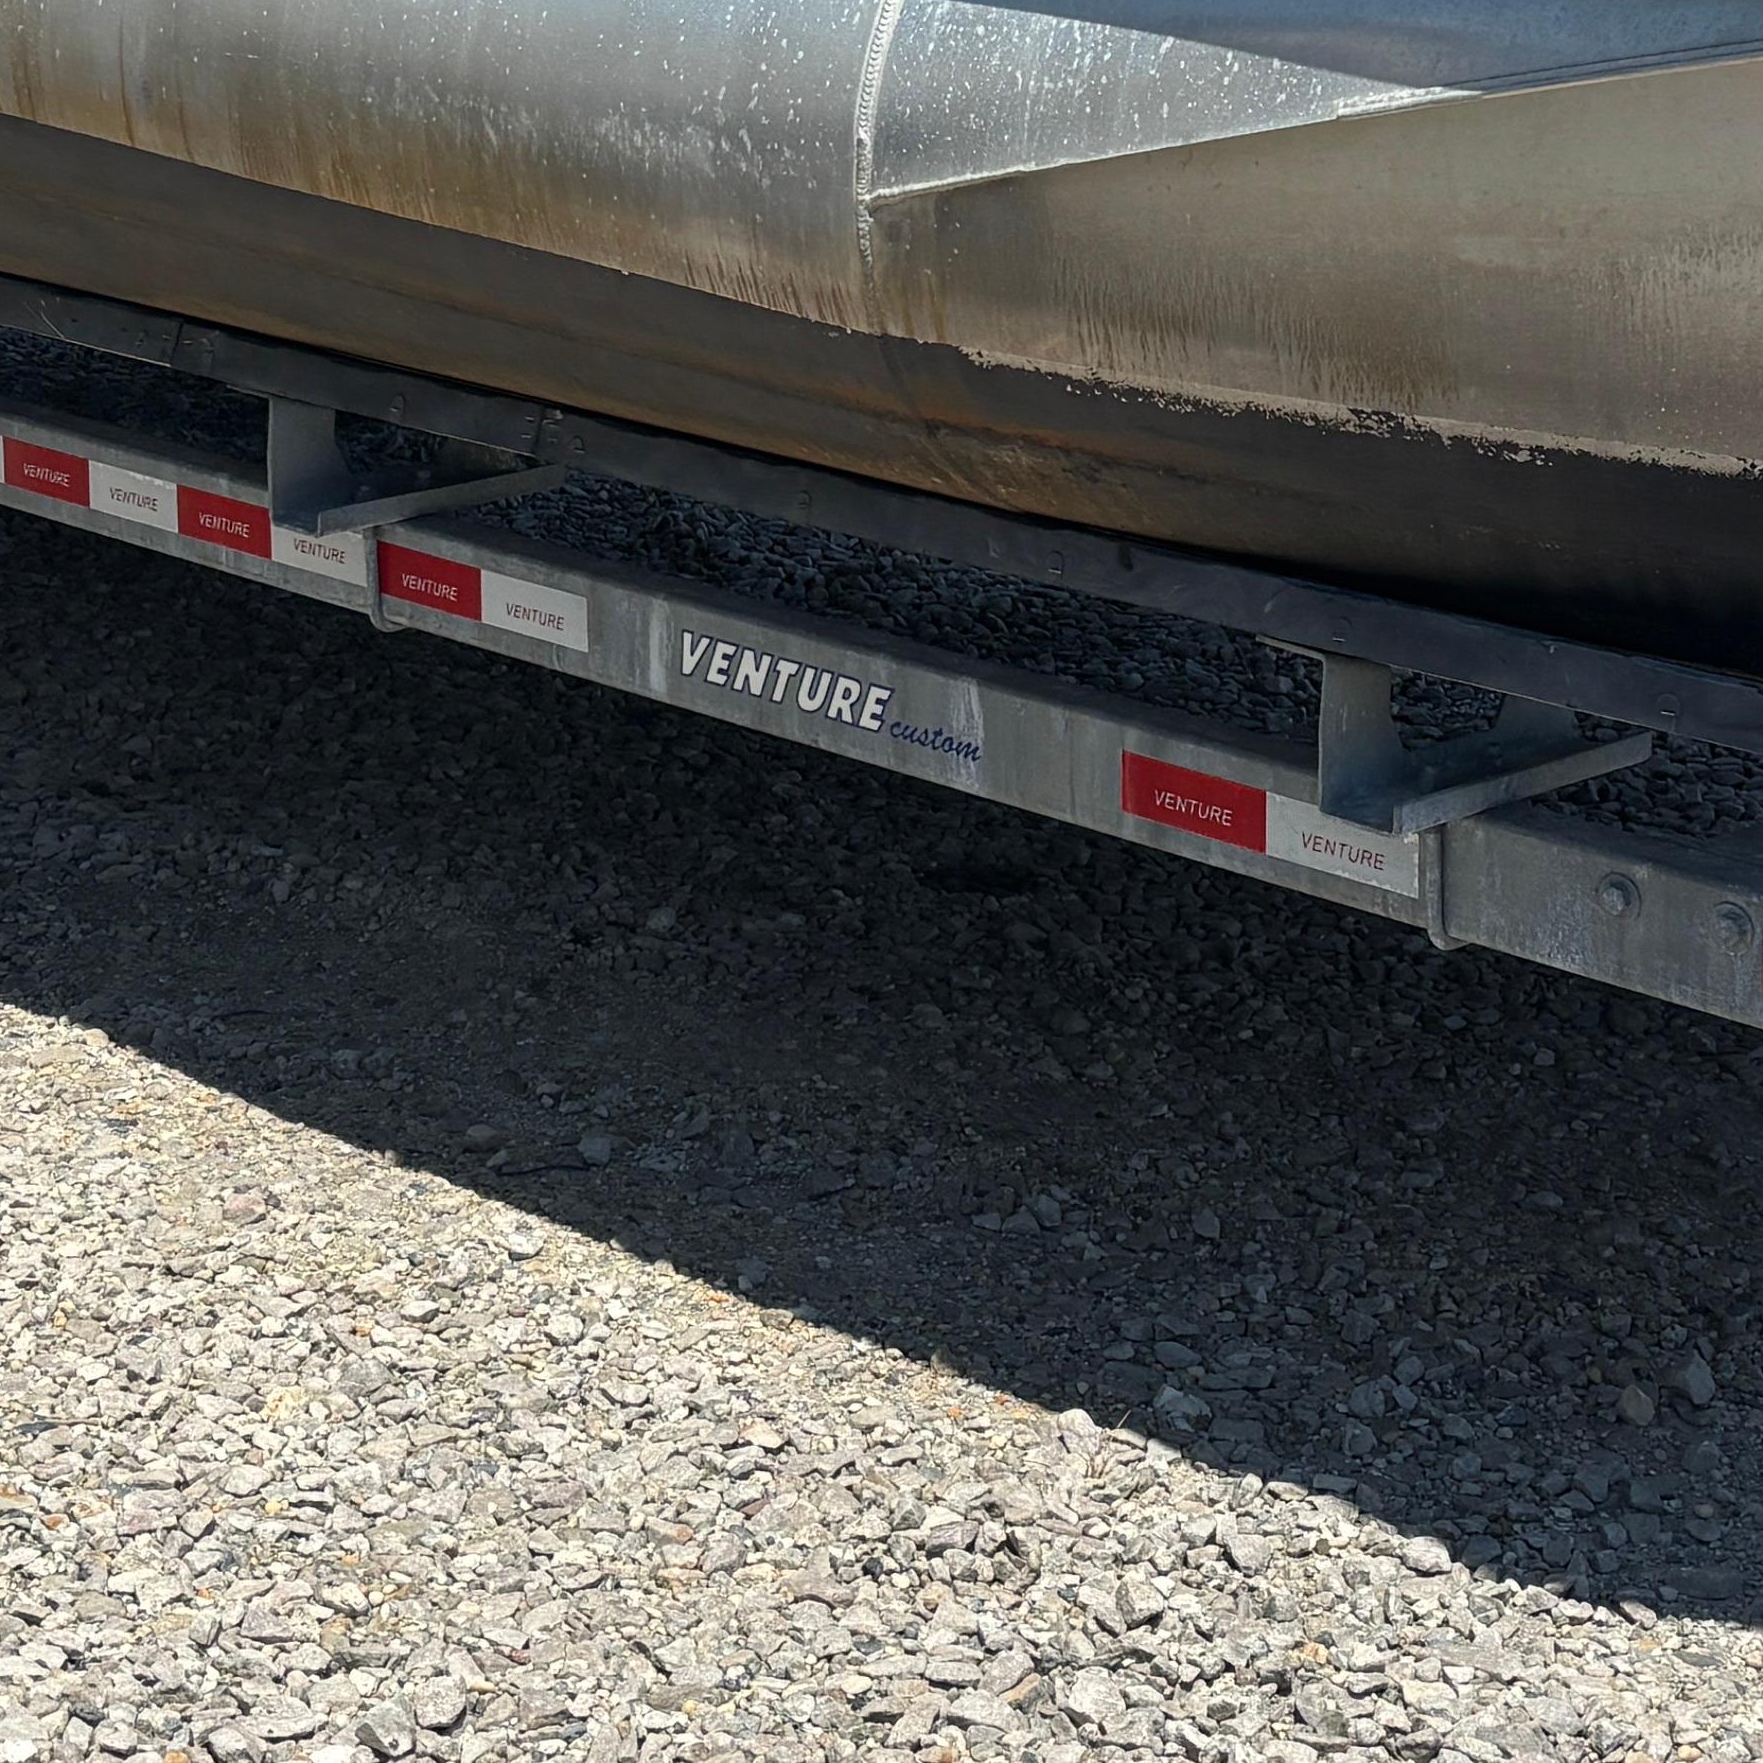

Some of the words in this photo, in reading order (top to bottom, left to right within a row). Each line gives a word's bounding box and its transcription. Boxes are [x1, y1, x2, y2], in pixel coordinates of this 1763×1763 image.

[22, 463, 70, 487] VENTURE
[109, 486, 159, 512] VENTURE
[198, 512, 251, 538] VENTURE
[293, 537, 346, 565] VENTURE
[401, 573, 459, 602] VENTURE
[505, 602, 565, 632] VENTURE
[680, 629, 894, 733] VENTURE
[890, 719, 982, 763] custom
[1153, 788, 1233, 828] VENTURE
[1301, 831, 1386, 871] VENTURE
